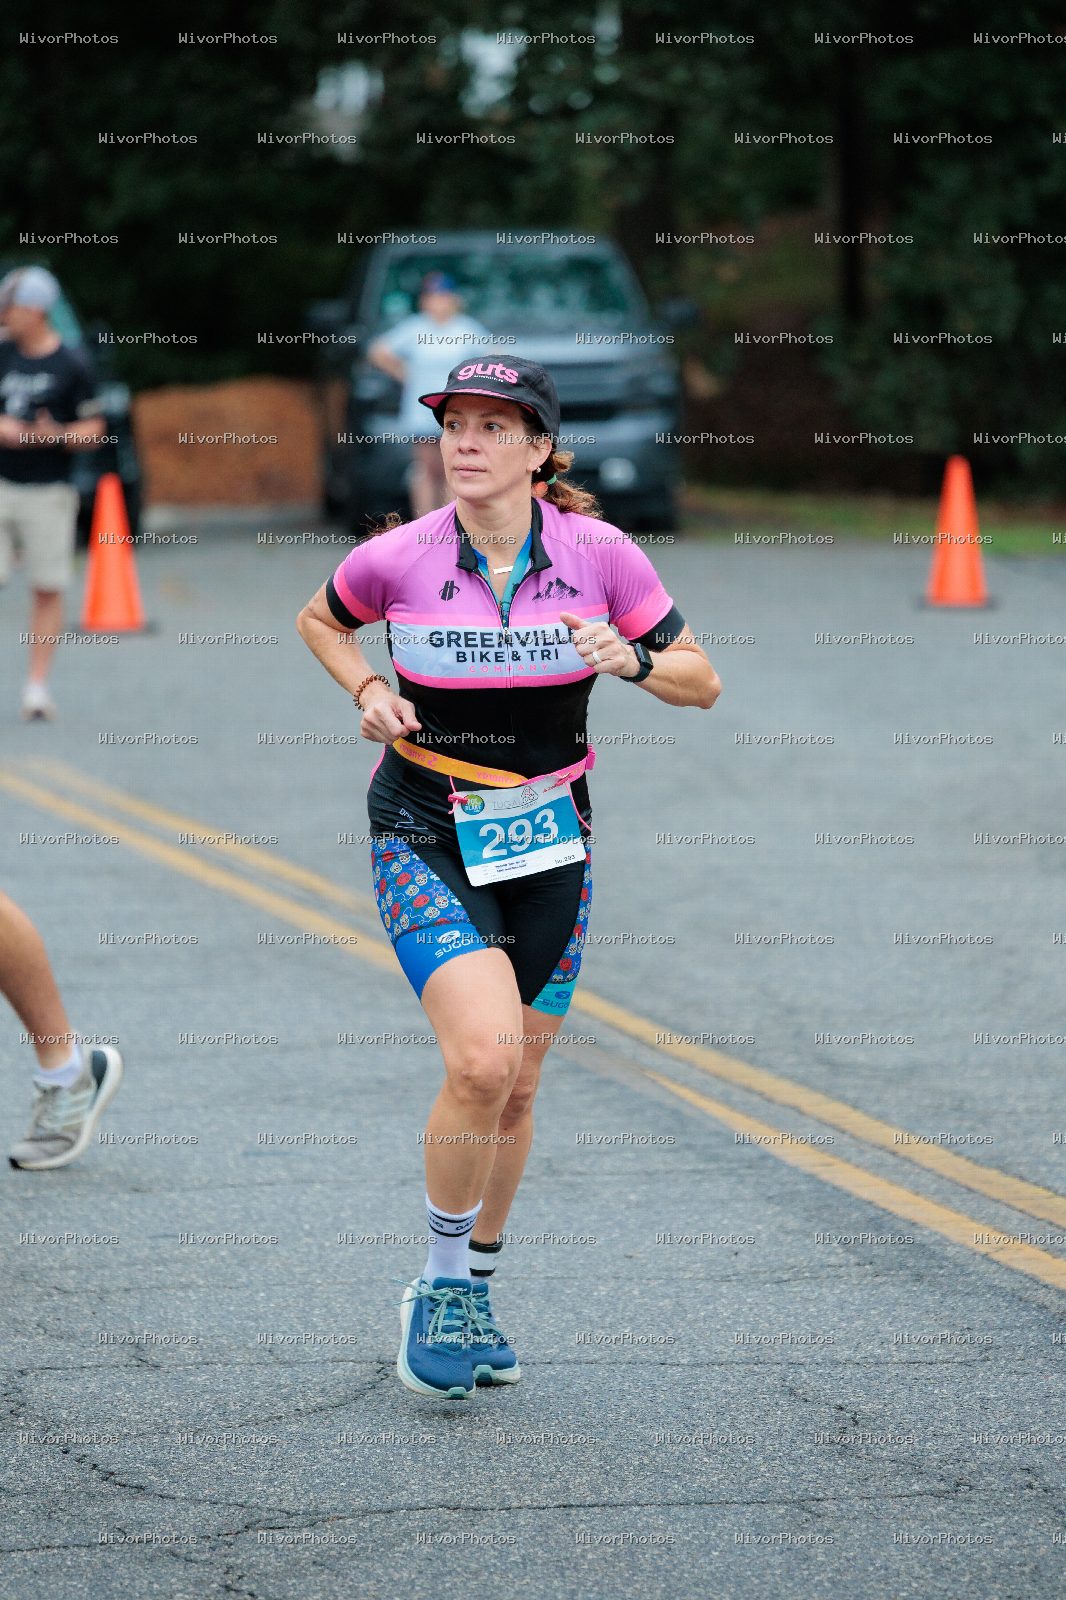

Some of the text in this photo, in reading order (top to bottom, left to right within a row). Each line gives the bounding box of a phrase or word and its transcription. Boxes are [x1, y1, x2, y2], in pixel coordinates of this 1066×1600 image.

[458, 363, 519, 384] guts
[456, 648, 559, 663] BIKE & TRI
[478, 808, 559, 859] 293
